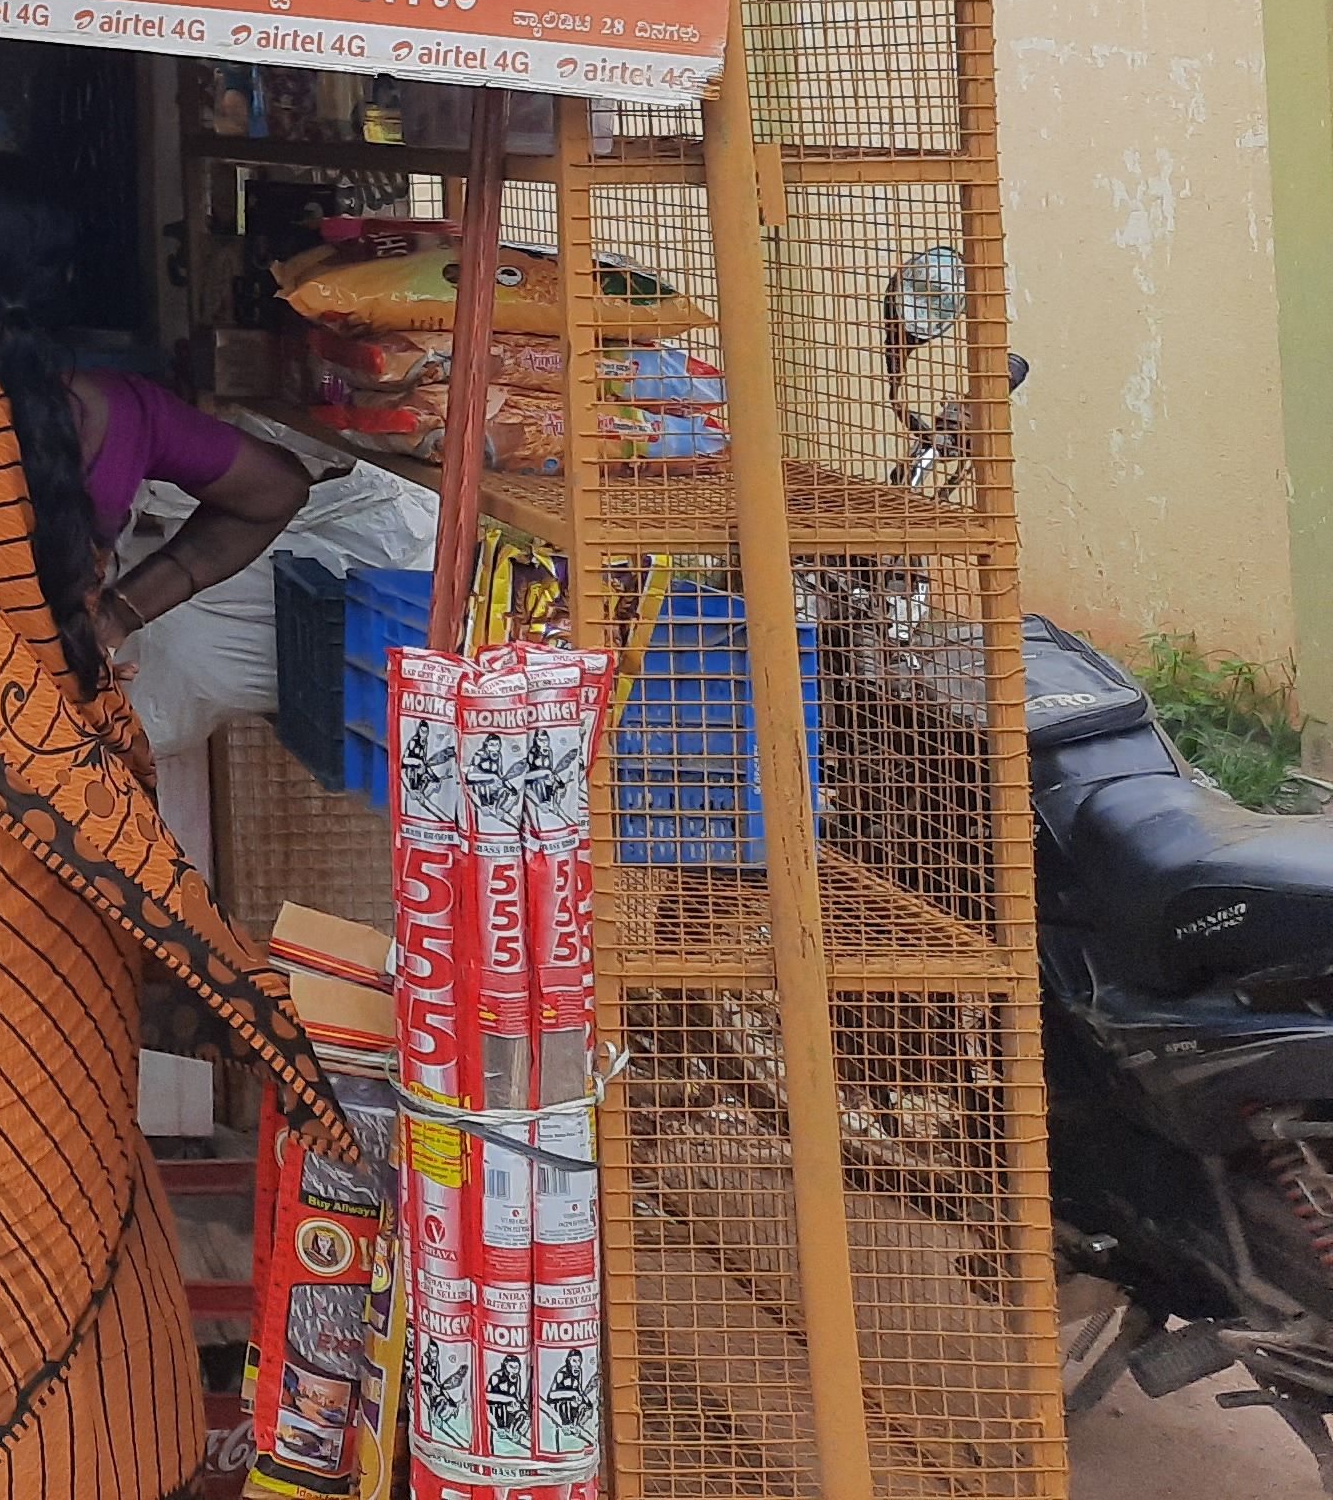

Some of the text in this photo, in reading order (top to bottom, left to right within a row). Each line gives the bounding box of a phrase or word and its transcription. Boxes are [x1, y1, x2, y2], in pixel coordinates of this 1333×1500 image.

[600, 17, 625, 36] 28
[635, 19, 701, 43] ದಿನಗಳು
[15, 3, 50, 27] 4G
[99, 11, 165, 38] airtel
[170, 17, 206, 42] 4G
[256, 27, 325, 54] airtel
[330, 34, 366, 58] 4G
[418, 43, 488, 71] airtel
[493, 51, 530, 75] 4G
[582, 59, 654, 87] airtel
[401, 692, 456, 719] MONKE
[526, 701, 577, 723] ONKEY
[308, 1195, 331, 1210] Buy
